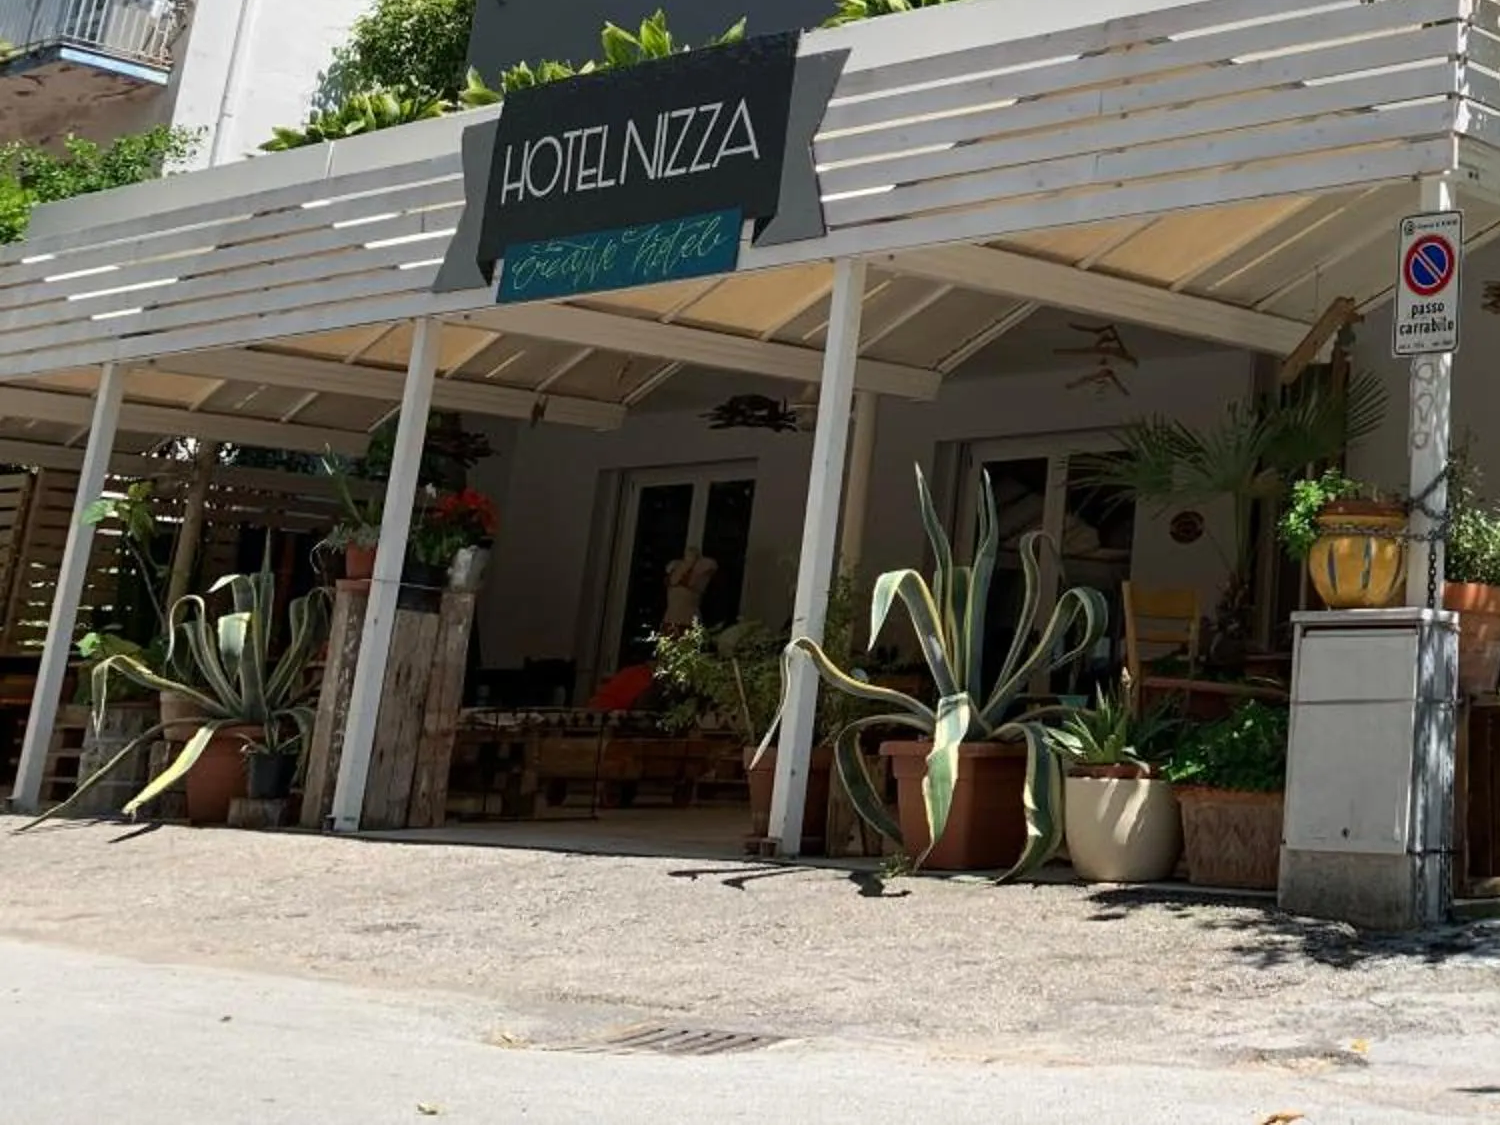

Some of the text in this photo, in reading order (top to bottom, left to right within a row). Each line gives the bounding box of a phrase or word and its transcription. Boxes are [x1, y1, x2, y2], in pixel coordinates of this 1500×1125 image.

[500, 97, 761, 205] HOTEL NIZZA
[1411, 302, 1445, 320] passo
[1399, 316, 1454, 336] carrabile
